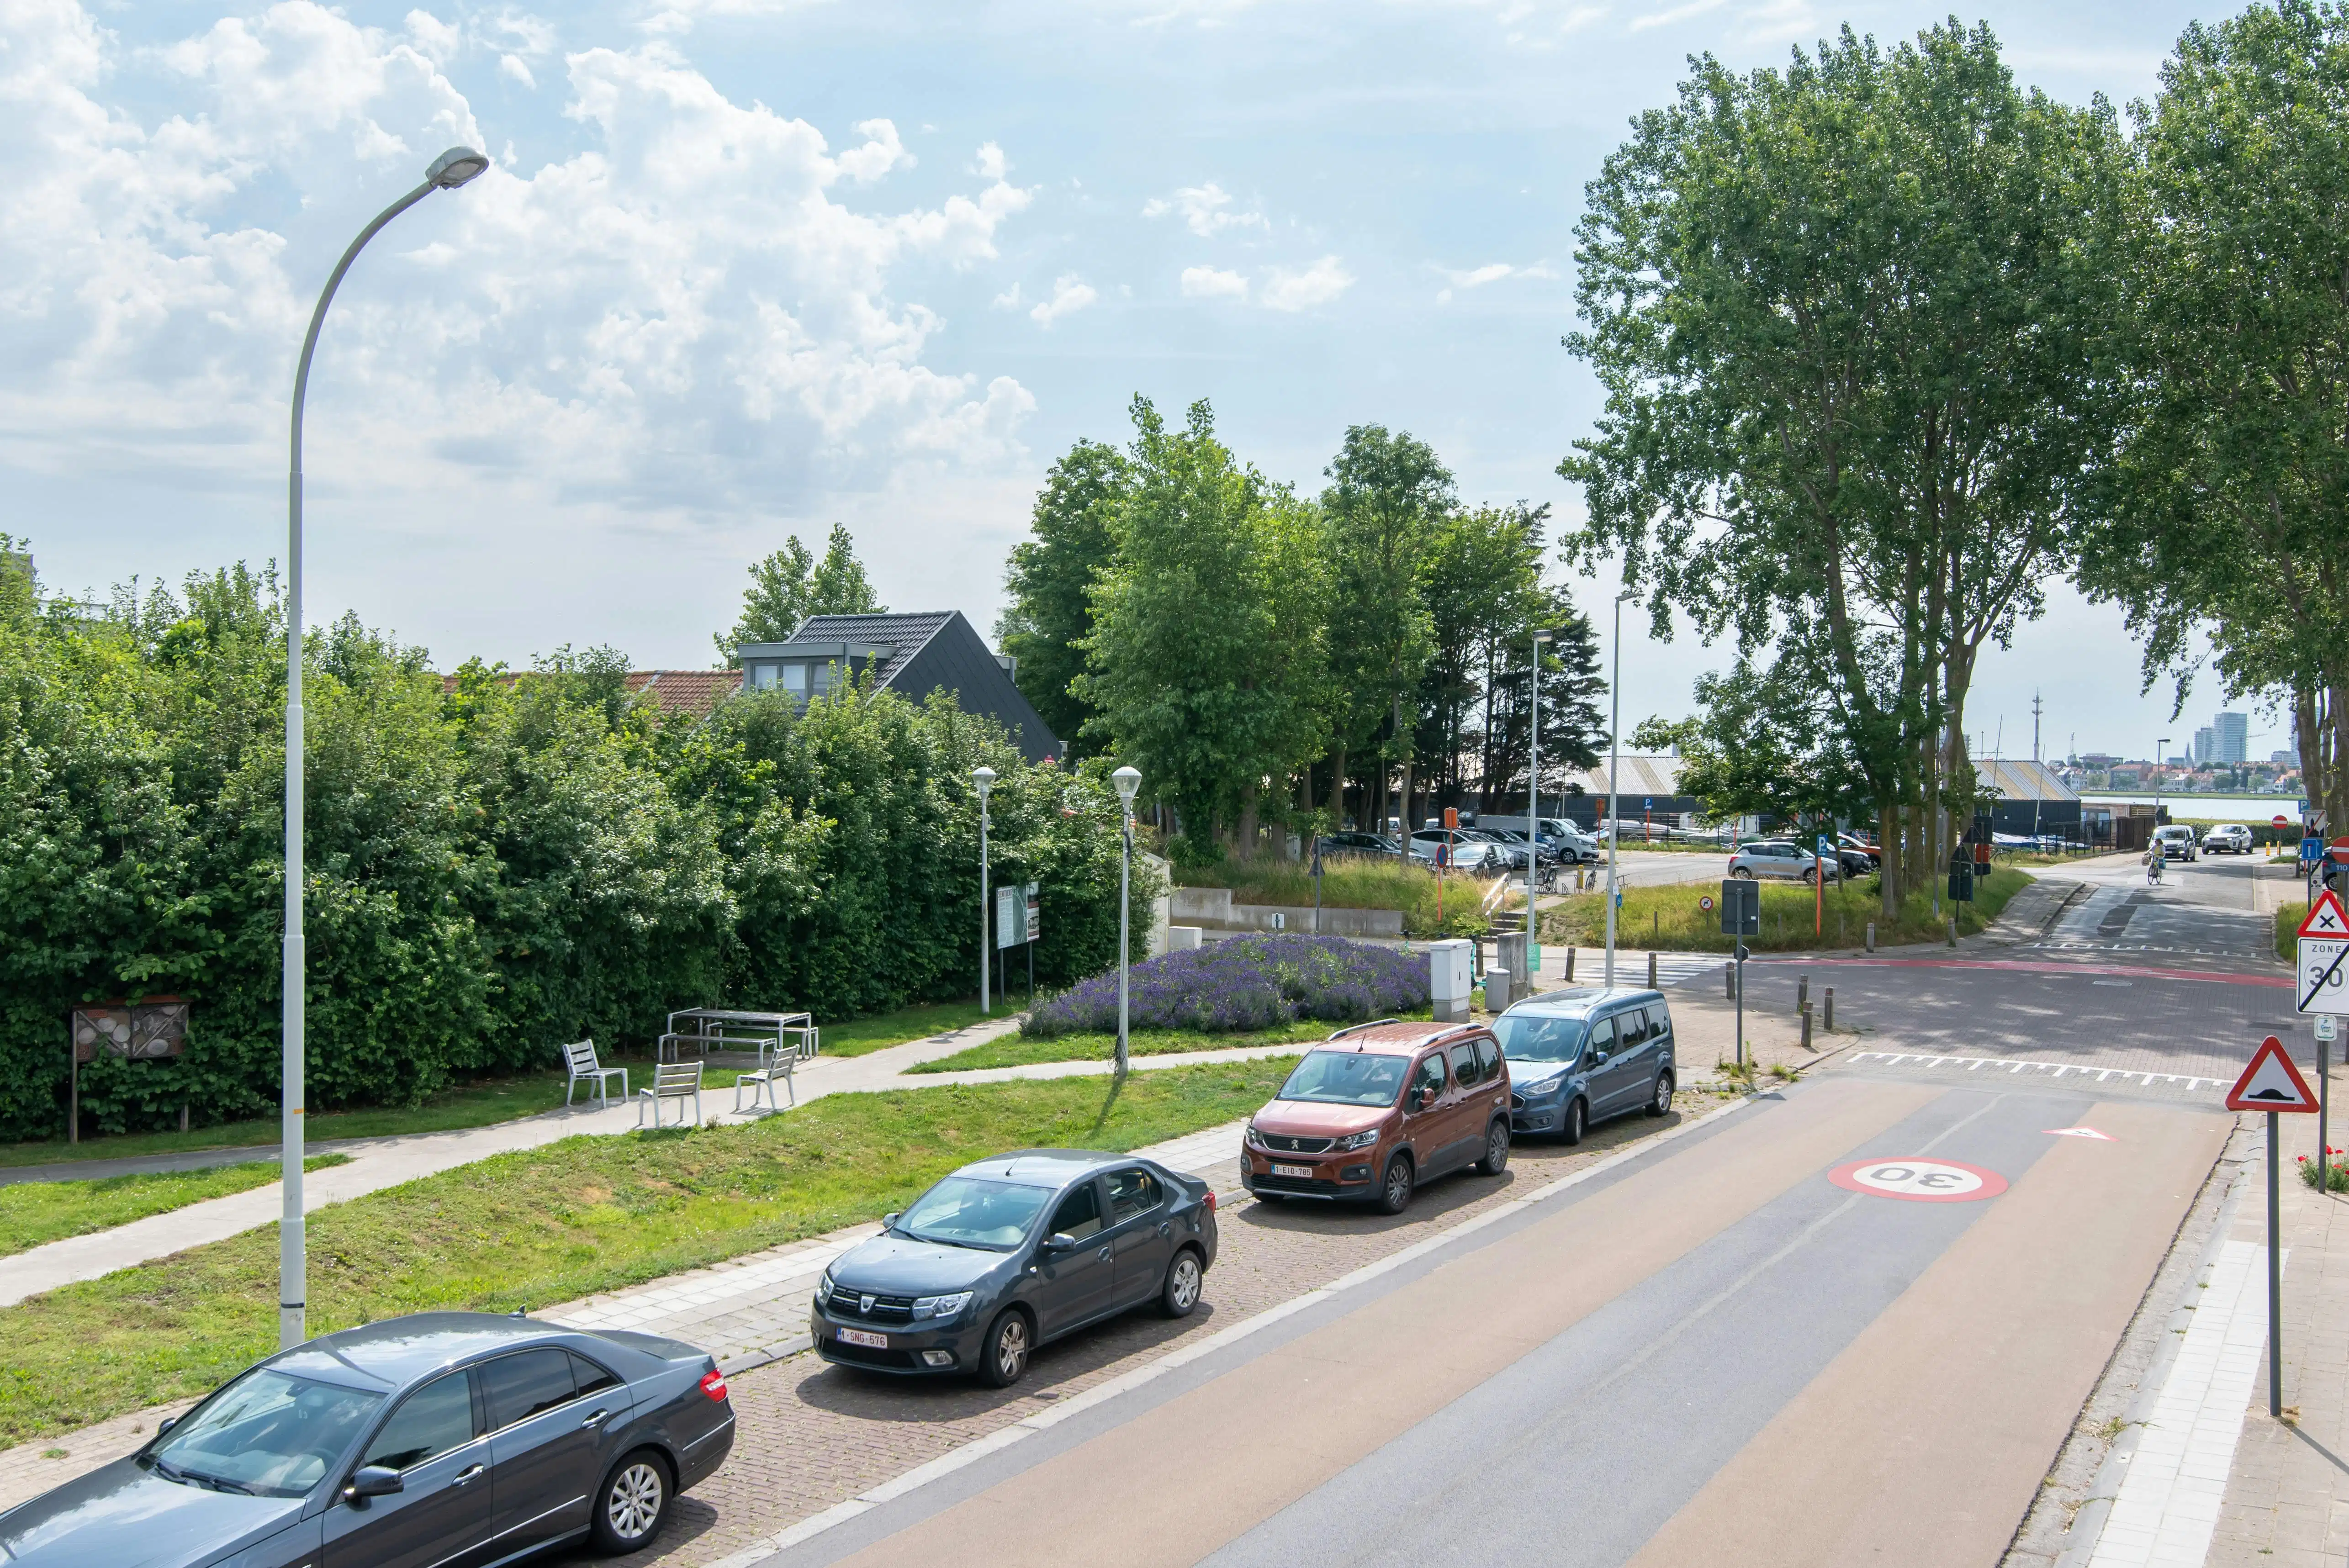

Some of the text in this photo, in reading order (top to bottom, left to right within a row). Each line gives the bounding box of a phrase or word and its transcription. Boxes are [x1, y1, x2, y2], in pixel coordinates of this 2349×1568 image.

[2301, 801, 2307, 809] P
[1819, 837, 1825, 852] P
[2312, 945, 2341, 953] ZONE
[2310, 966, 2343, 987] 30
[1870, 1167, 1963, 1188] 30
